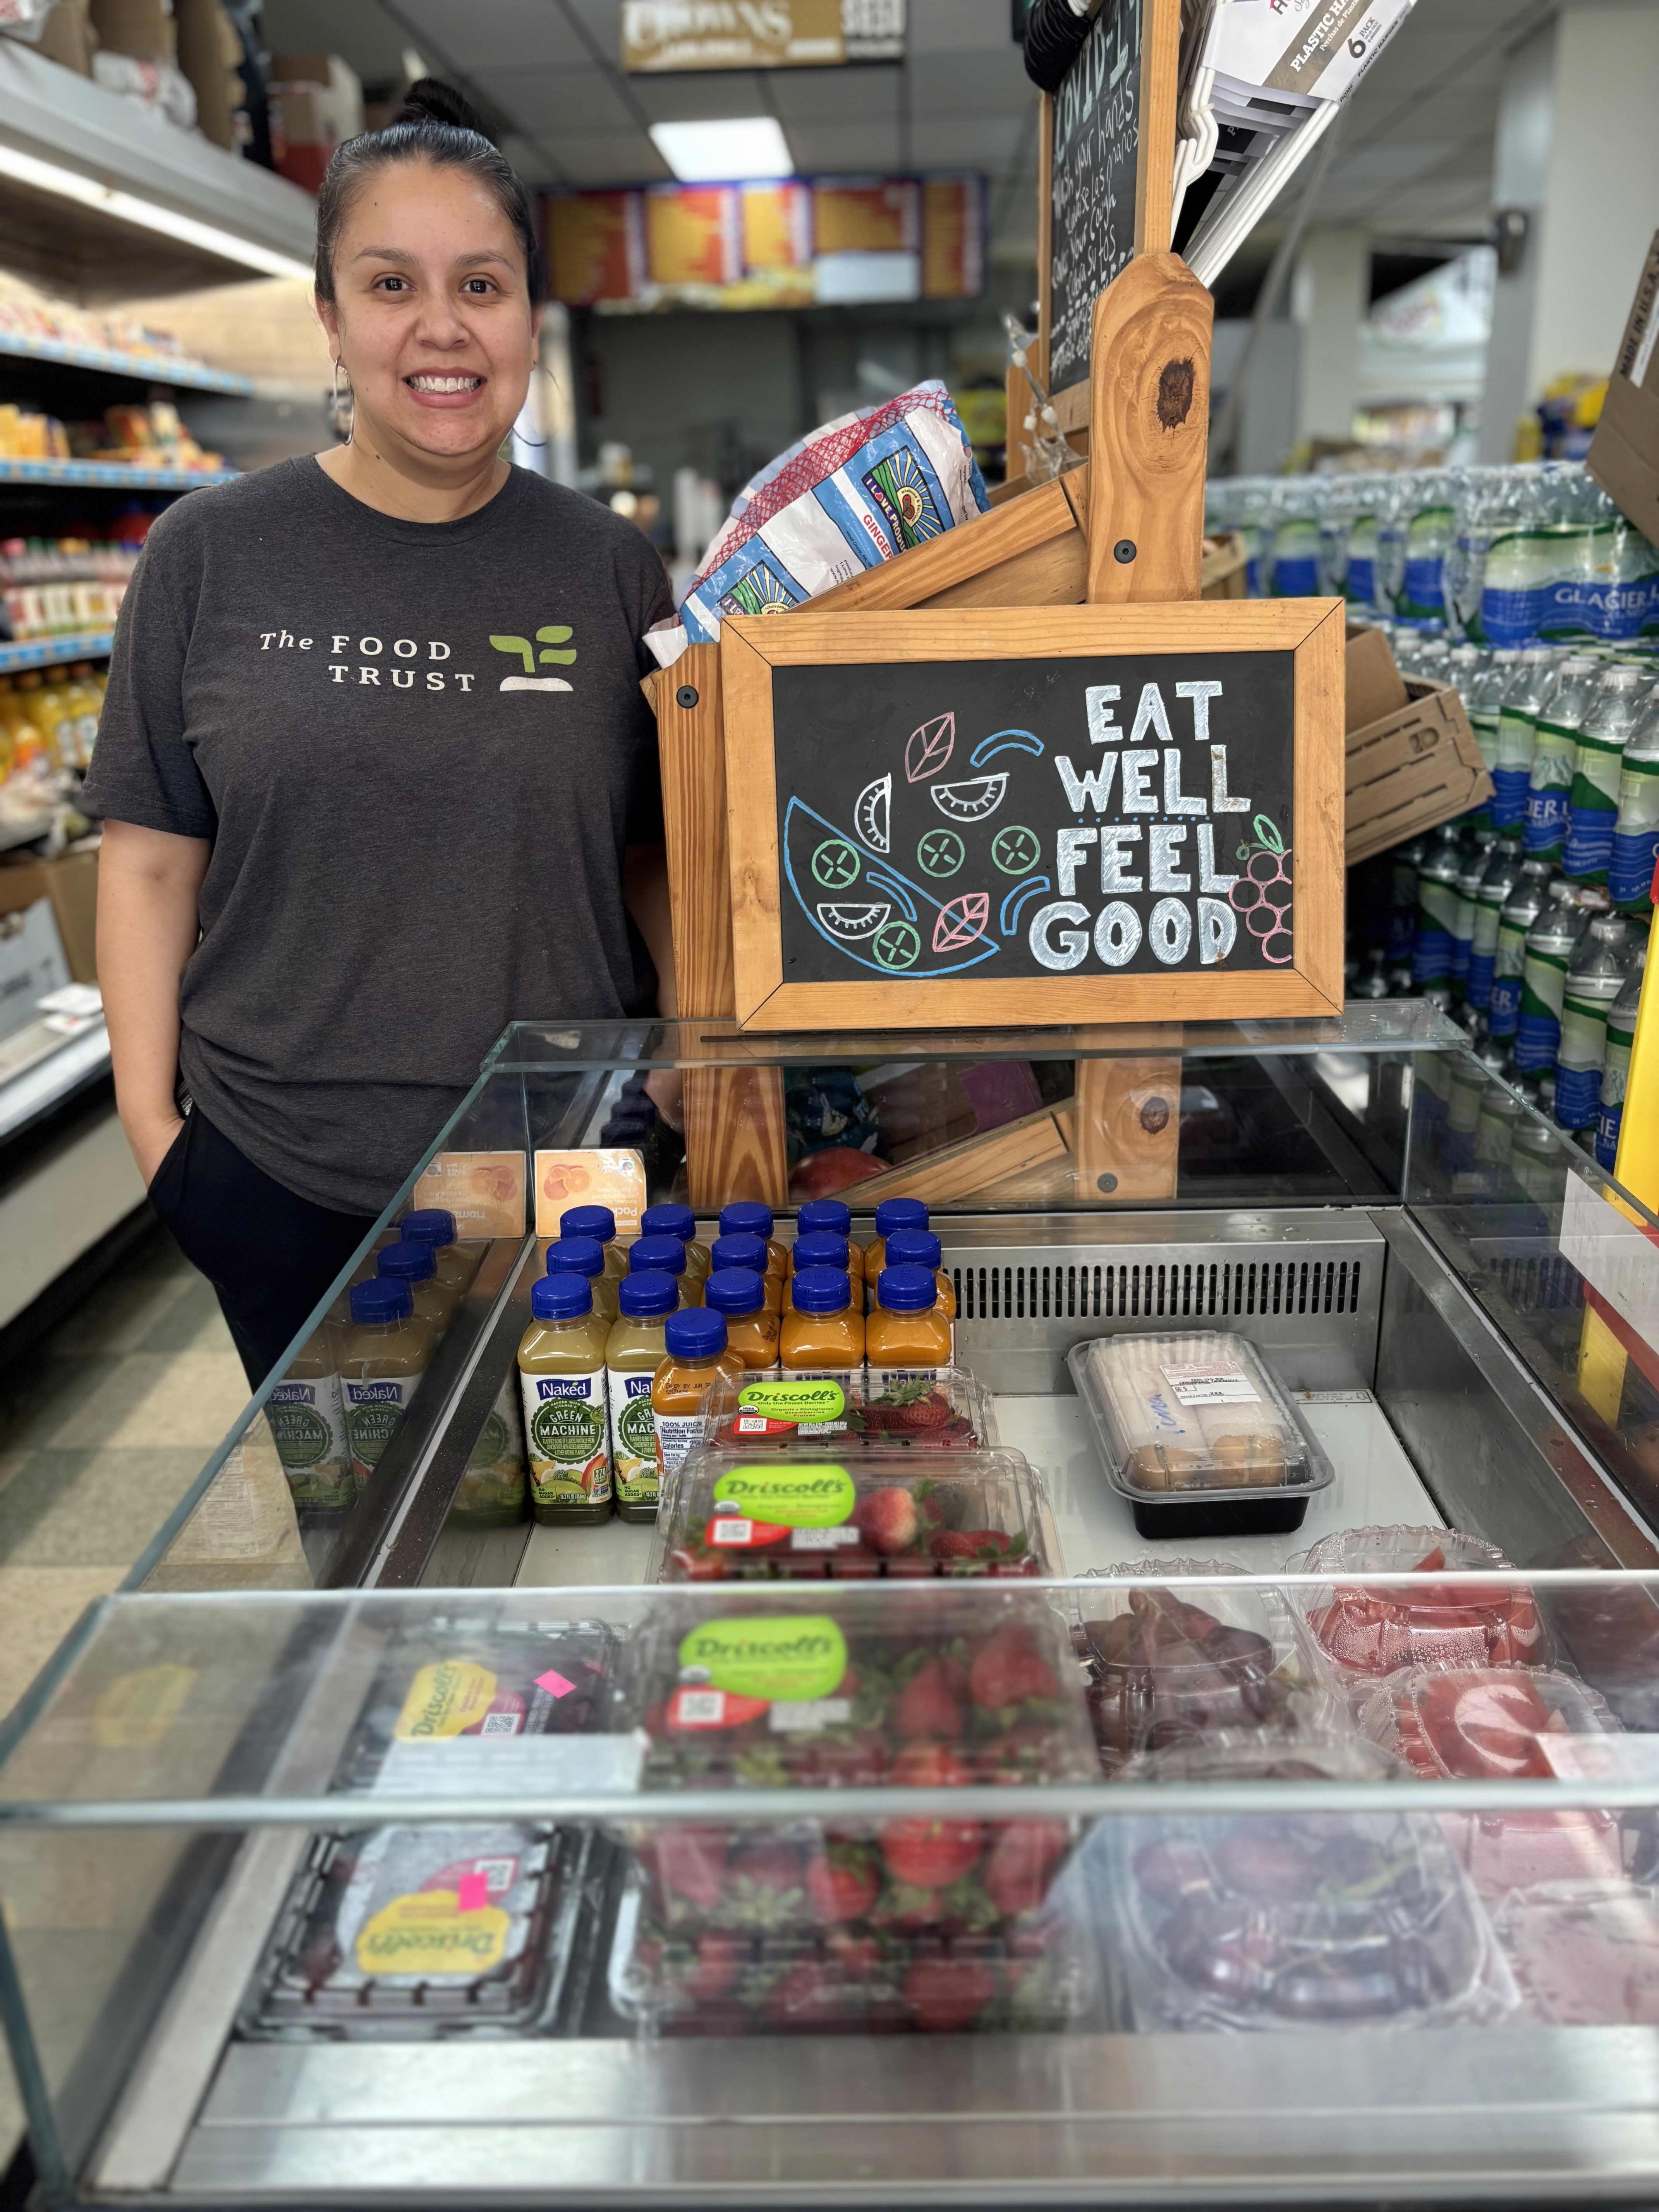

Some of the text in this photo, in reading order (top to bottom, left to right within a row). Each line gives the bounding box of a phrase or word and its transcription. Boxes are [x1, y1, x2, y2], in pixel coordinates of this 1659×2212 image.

[1319, 26, 1339, 51] Perchas
[1337, 16, 1345, 27] de
[1359, 17, 1376, 38] PACK
[1290, 13, 1334, 72] PLASTIC
[1347, 38, 1366, 59] 6
[1075, 69, 1134, 201] your hands
[1554, 587, 1647, 610] GLACIER
[260, 629, 451, 661] The FOOD
[328, 665, 476, 692] TRUST
[1085, 680, 1223, 744] EAT
[1054, 744, 1251, 816] WELL
[1056, 823, 1239, 896] FEEL
[1029, 897, 1238, 971] GOOD
[543, 1382, 586, 1396] Naked
[747, 1390, 837, 1401] Driscoll's
[550, 1410, 583, 1423] GREEN
[540, 1424, 596, 1436] MACHINE
[595, 1467, 606, 1477] 270
[726, 1479, 846, 1494] Driscoll's
